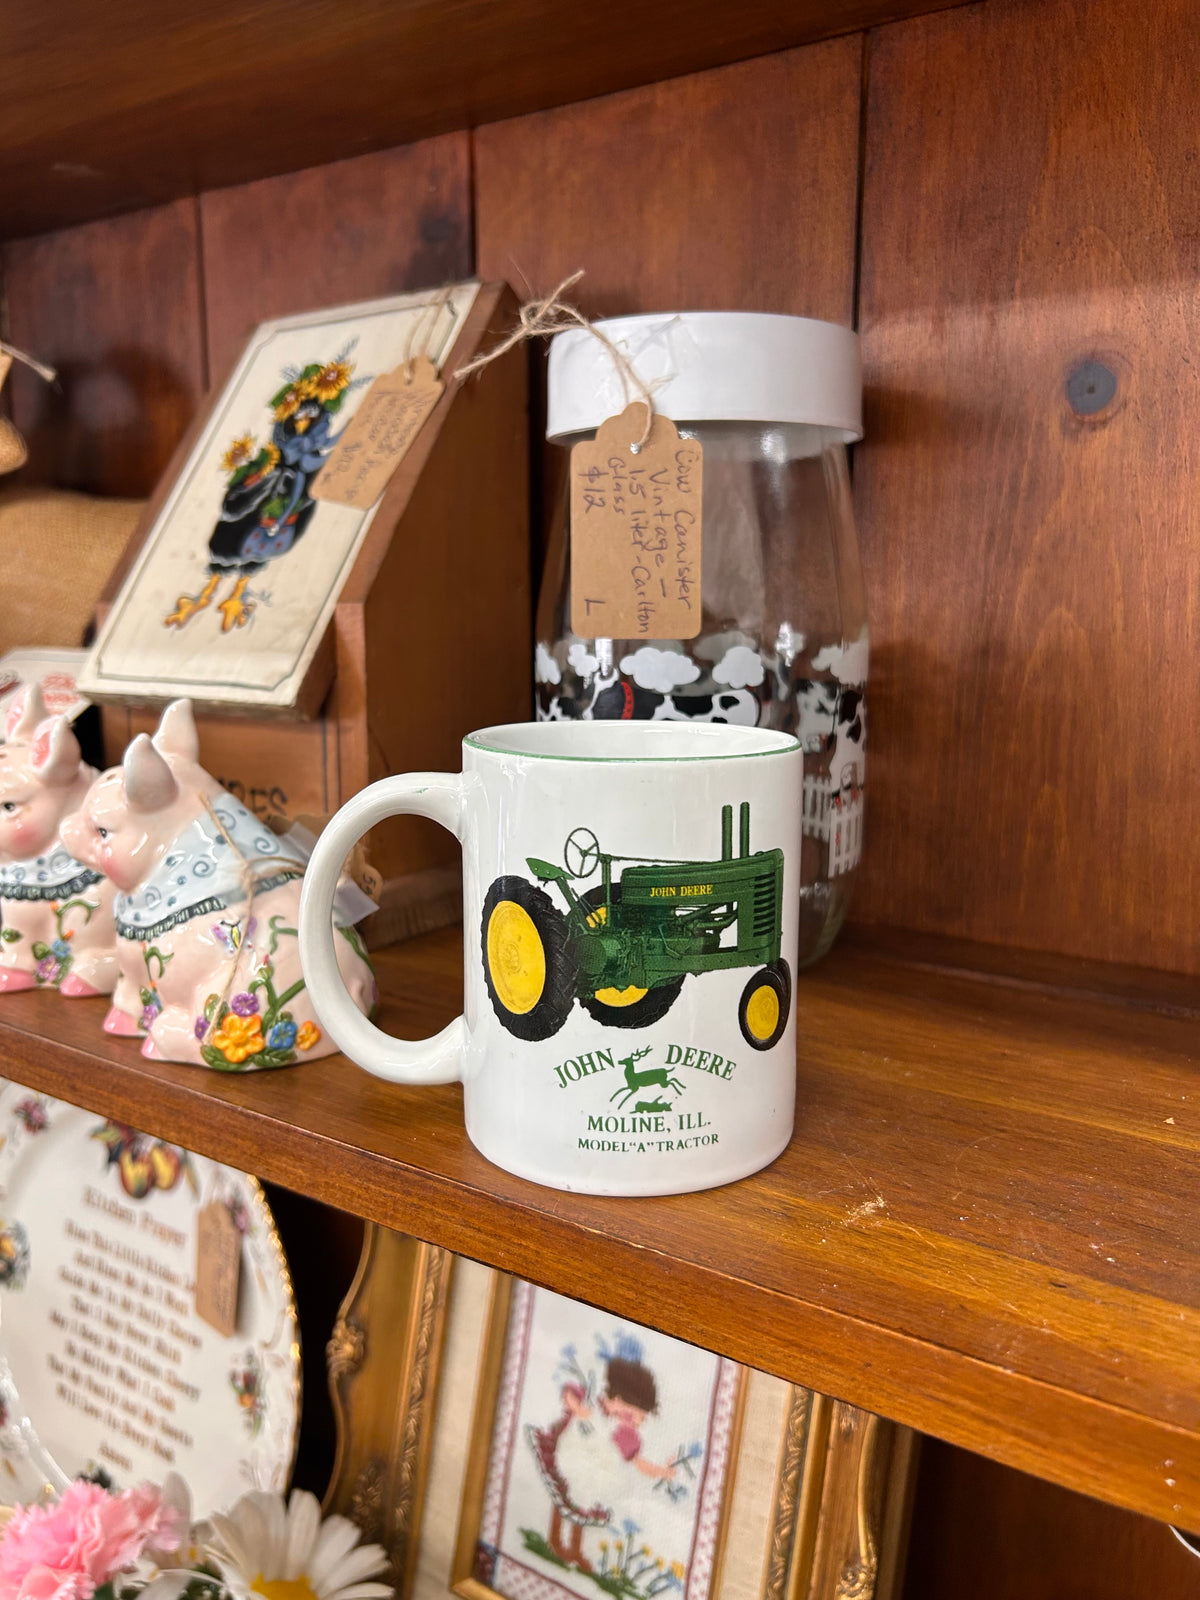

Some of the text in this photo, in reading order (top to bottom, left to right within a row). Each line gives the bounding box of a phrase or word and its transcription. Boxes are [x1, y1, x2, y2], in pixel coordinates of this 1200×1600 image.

[578, 466, 609, 514] $12
[607, 456, 627, 516] Glass
[628, 469, 646, 500] 1.5
[629, 510, 648, 550] liter
[644, 468, 670, 568] Vintage
[673, 450, 699, 610] Cow Canister
[650, 884, 713, 897] JOHN DEERE
[553, 1044, 737, 1088] JOHN DEERE
[587, 1111, 711, 1133] MOLINE, ILL.
